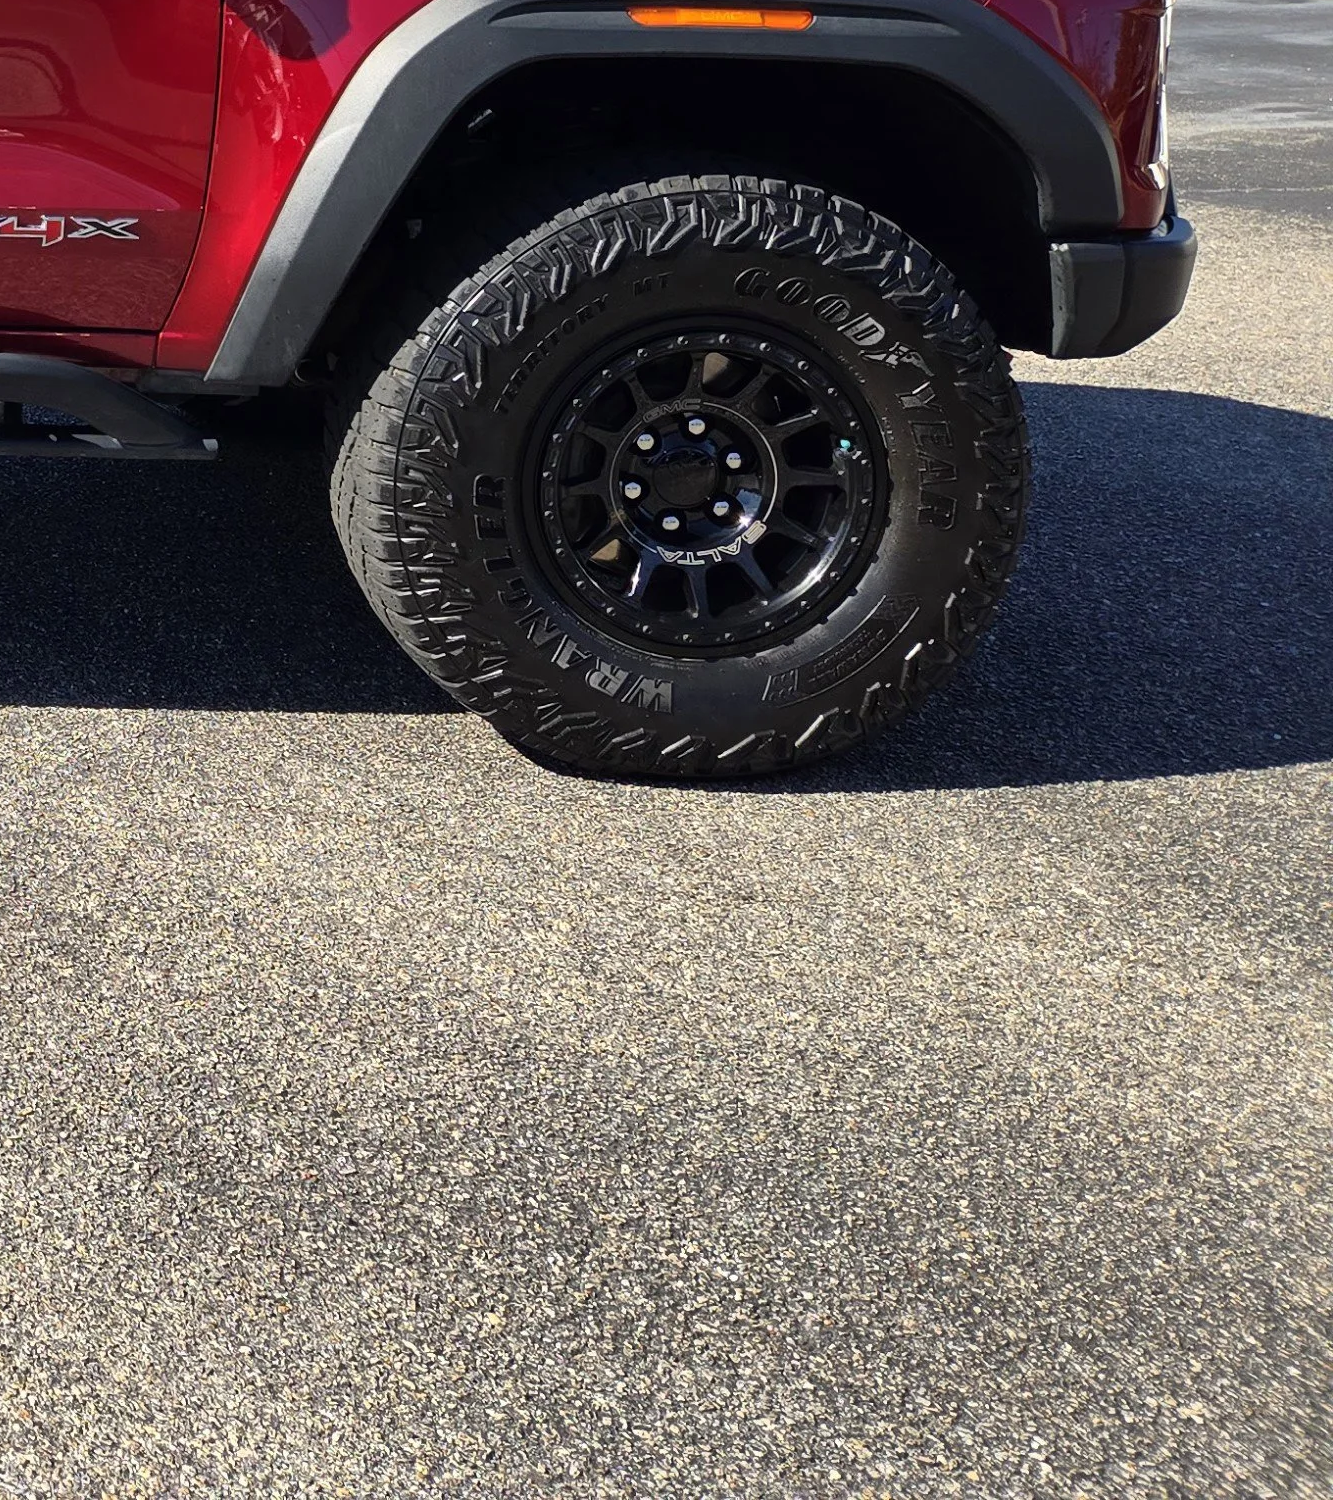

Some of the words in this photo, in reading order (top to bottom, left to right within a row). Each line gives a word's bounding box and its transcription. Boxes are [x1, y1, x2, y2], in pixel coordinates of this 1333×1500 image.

[492, 292, 609, 413] TERRITORY
[642, 398, 702, 423] GMC
[655, 519, 768, 566] SALTA
[472, 473, 675, 716] WRANGLER
